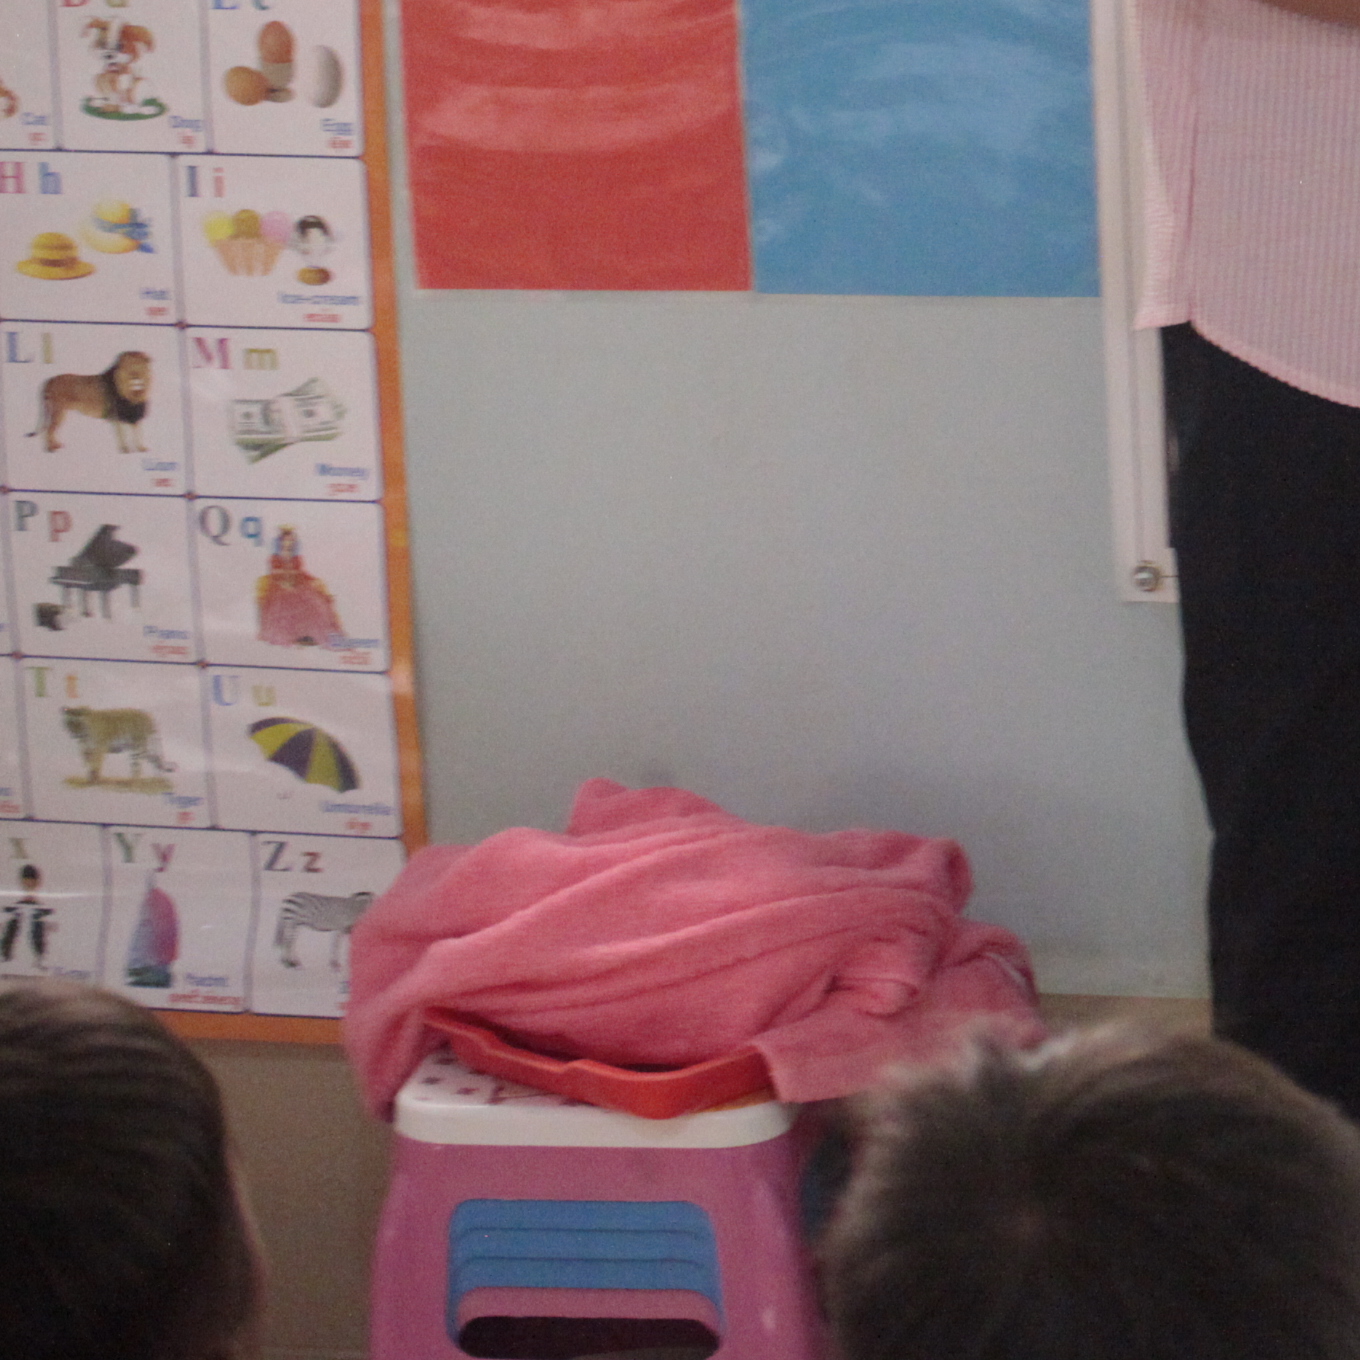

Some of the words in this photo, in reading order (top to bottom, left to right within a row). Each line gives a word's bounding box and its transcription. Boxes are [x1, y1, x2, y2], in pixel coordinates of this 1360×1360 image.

[0, 161, 27, 194] H
[38, 162, 62, 194] h
[212, 167, 225, 197] i
[5, 331, 34, 364] L
[192, 336, 232, 370] M
[243, 348, 280, 370] m
[14, 500, 40, 532] P
[47, 510, 73, 542] p
[198, 505, 232, 546] Q
[240, 516, 263, 547] q
[25, 666, 52, 698] T
[65, 674, 79, 698] t
[212, 674, 240, 706] U
[251, 684, 276, 707] u
[114, 832, 142, 863] Y
[150, 843, 176, 873] y
[262, 841, 293, 872] Z
[301, 852, 324, 873] z
